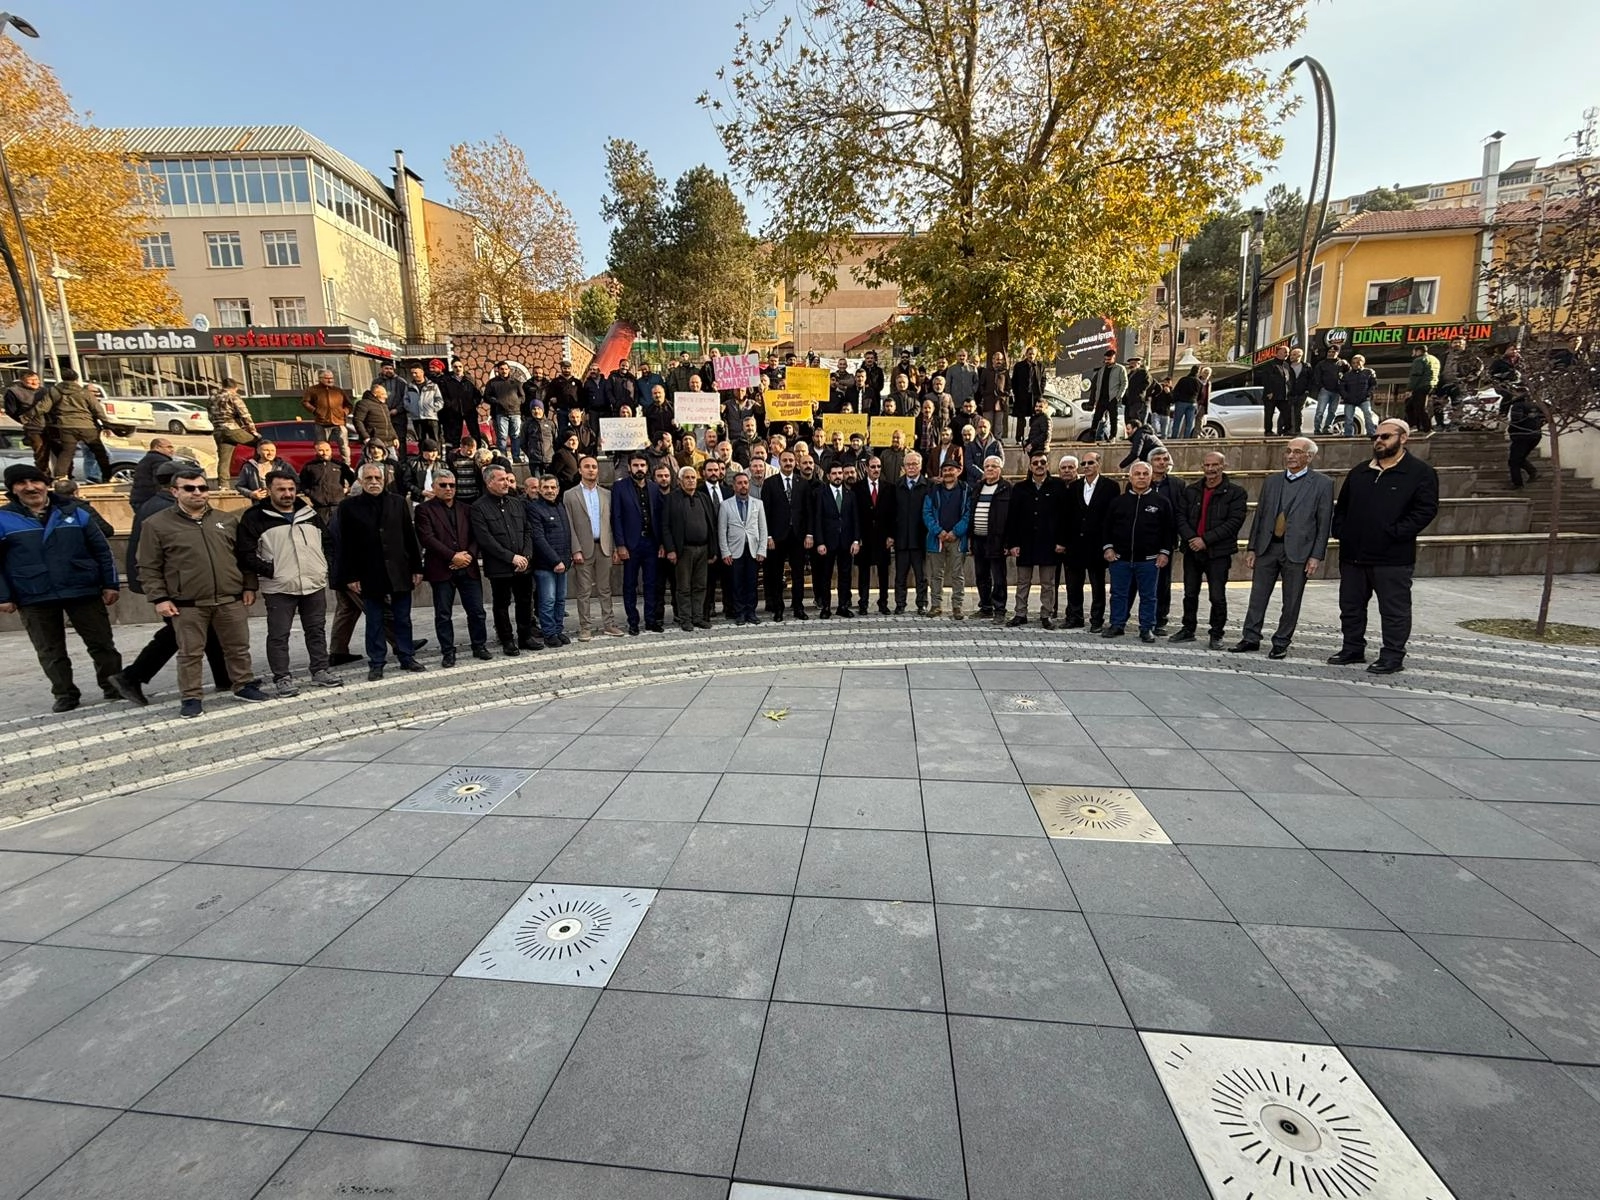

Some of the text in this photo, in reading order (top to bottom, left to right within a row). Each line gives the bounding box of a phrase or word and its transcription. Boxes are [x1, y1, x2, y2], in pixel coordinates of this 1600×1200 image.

[96, 329, 326, 350] Hacıbaba restaurant
[1352, 326, 1403, 344] DÖNER
[714, 355, 750, 369] HALK
